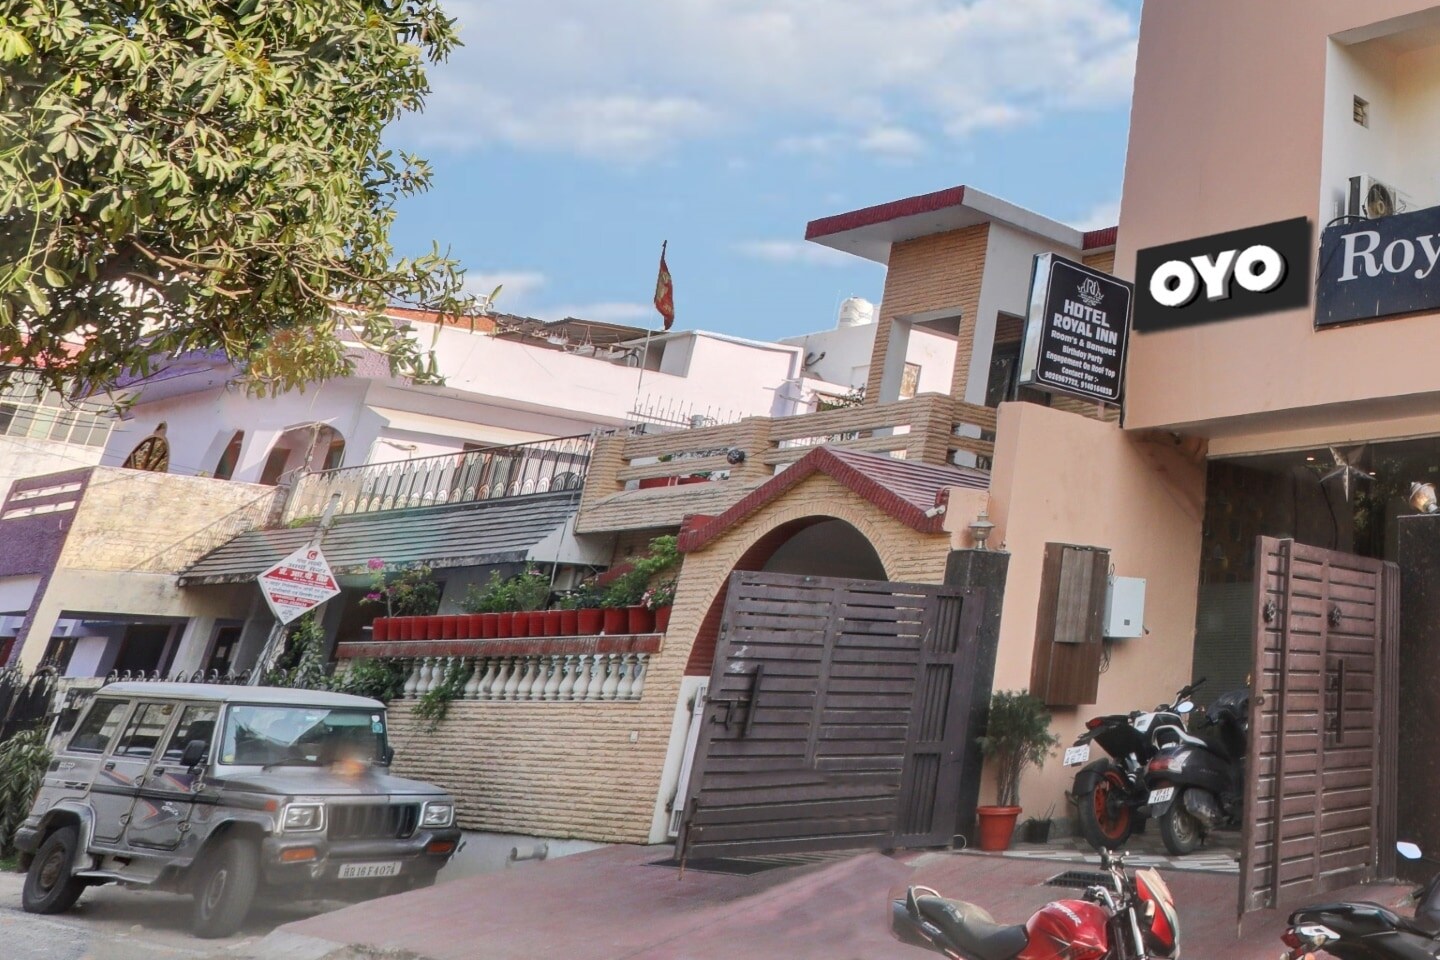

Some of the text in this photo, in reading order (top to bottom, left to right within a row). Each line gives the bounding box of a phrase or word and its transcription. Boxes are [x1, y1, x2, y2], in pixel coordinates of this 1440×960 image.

[1150, 244, 1286, 307] OYO
[1063, 298, 1110, 328] HOTEL
[1053, 312, 1118, 345] ROYAL INN
[1051, 330, 1116, 357] Room's & Banquet
[1062, 345, 1103, 365] Birthday Party
[1046, 351, 1083, 368] Engagement
[1105, 368, 1116, 379] Top
[1061, 366, 1084, 379] Contact
